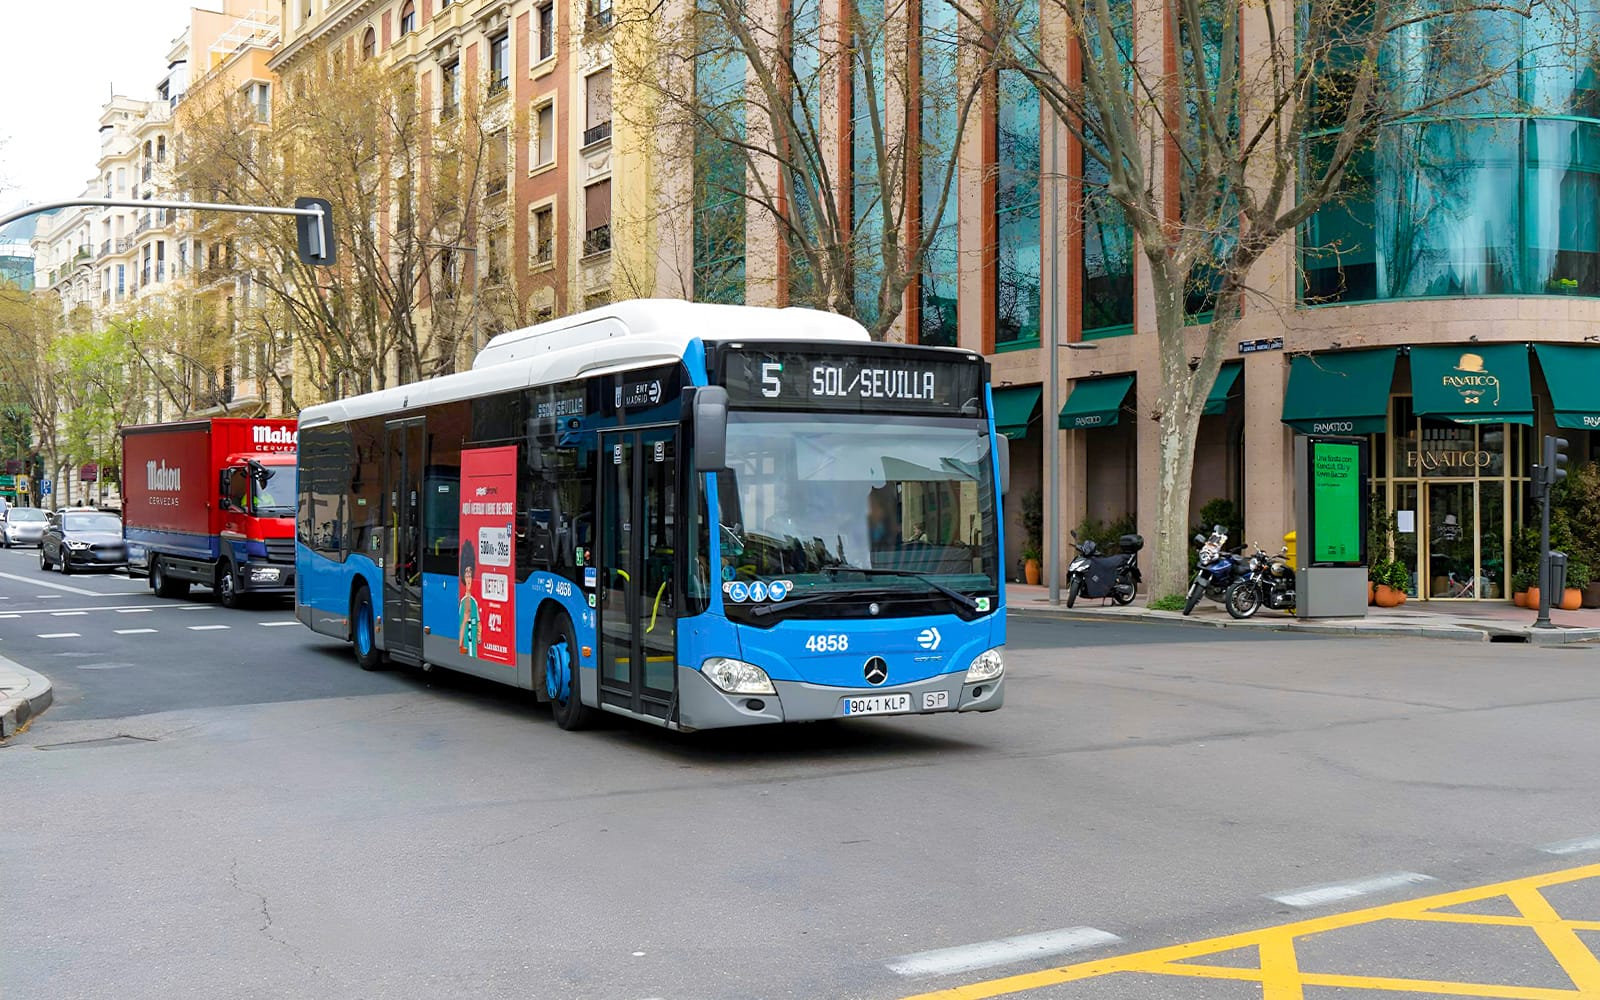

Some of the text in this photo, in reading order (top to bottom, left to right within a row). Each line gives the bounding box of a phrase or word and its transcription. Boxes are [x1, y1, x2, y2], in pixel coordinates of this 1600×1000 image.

[761, 363, 934, 399] 5 SOL/SEVILLA
[1443, 375, 1497, 387] FANATICO
[626, 393, 648, 405] MADRID
[1313, 421, 1353, 432] FANATICO
[1407, 450, 1491, 470] FANATICO
[146, 459, 181, 491] Mahou
[149, 496, 179, 506] CERVEZAS
[555, 582, 572, 597] 4858
[805, 634, 849, 652] 4858
[851, 696, 906, 714] 9041 KLP
